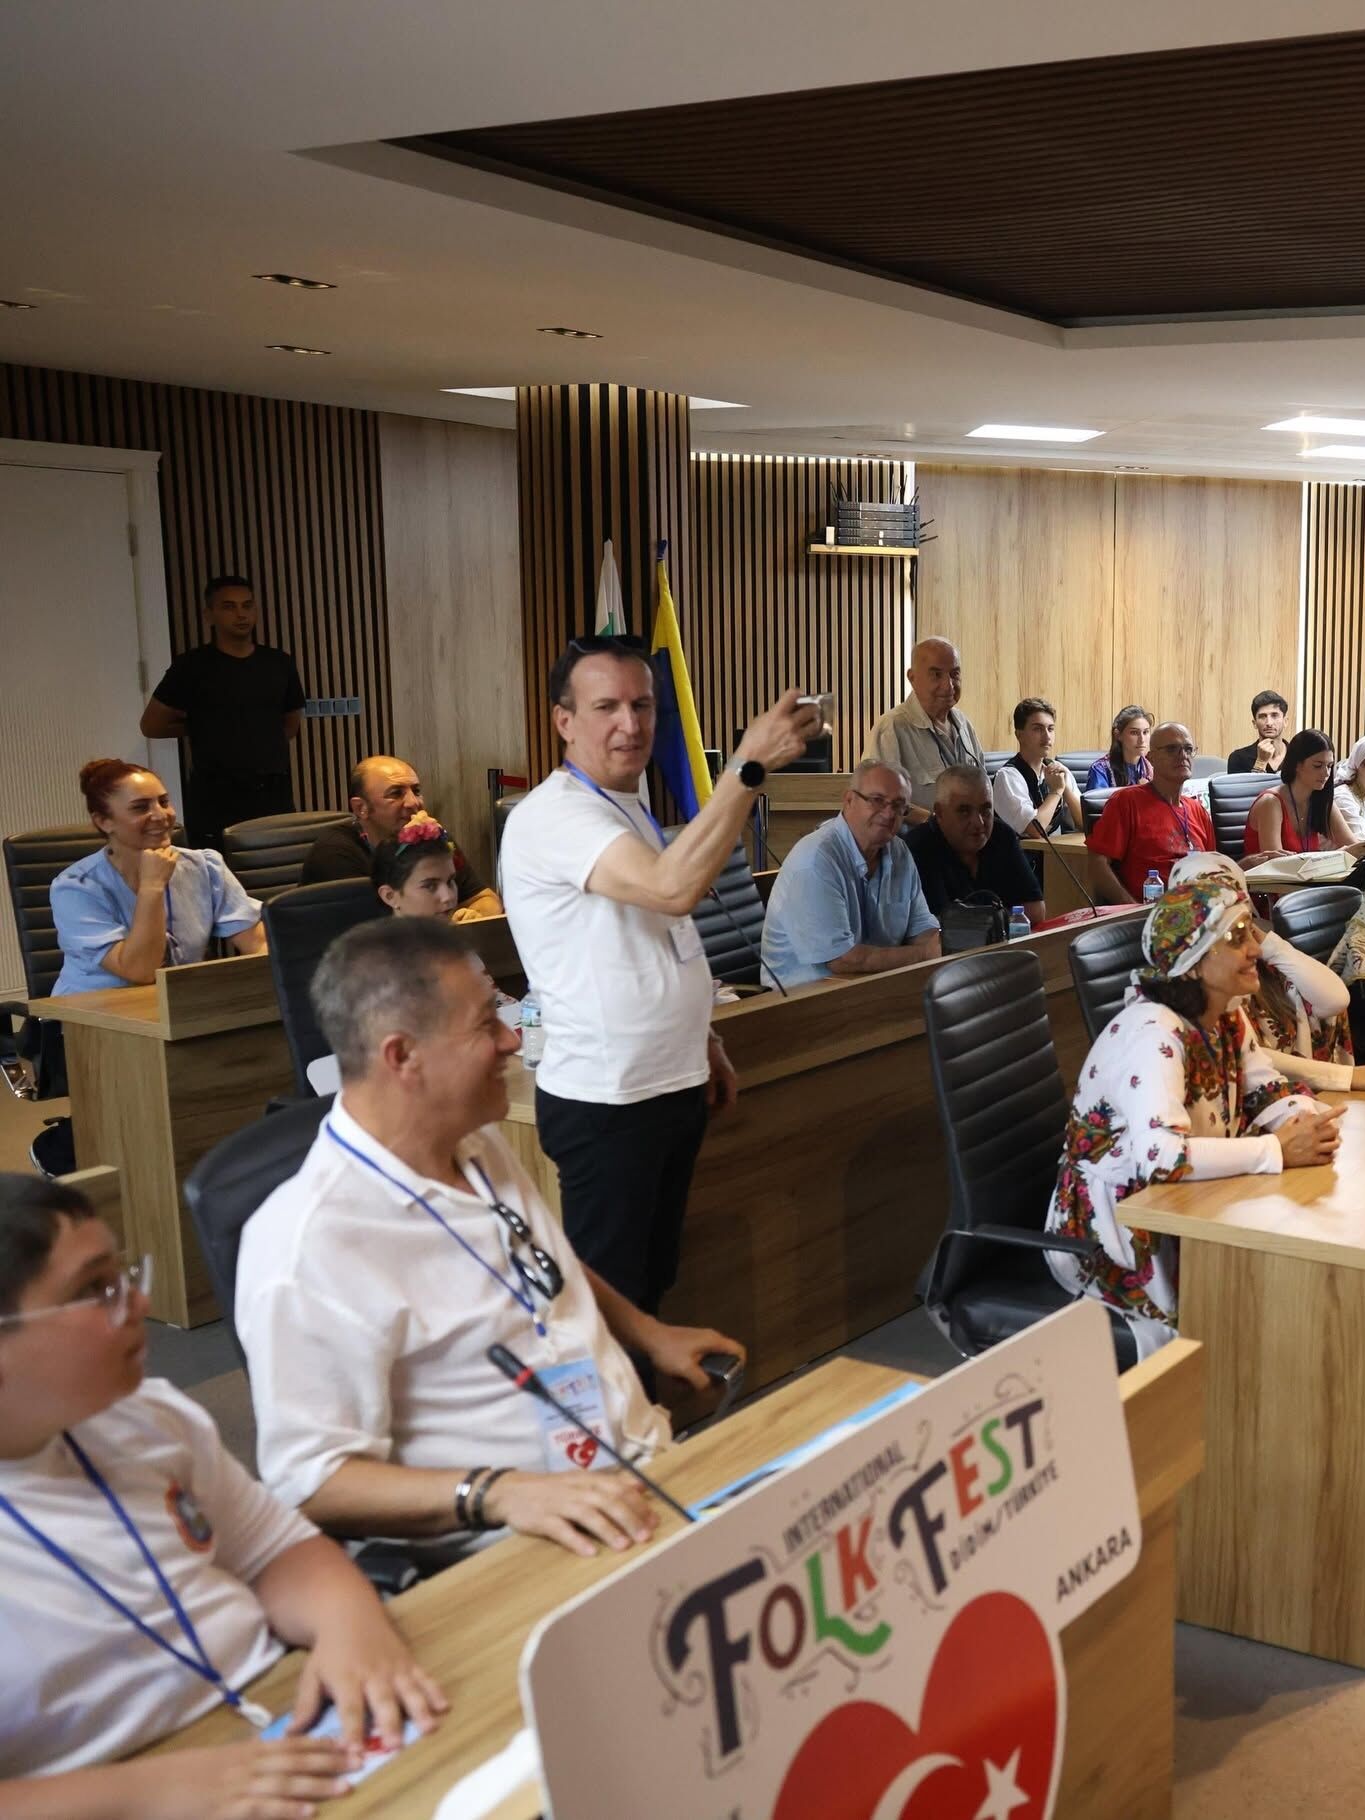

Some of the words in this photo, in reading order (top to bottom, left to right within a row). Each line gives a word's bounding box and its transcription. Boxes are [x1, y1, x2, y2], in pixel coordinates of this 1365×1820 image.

[783, 1440, 905, 1553] INTERNATIONAL
[666, 1515, 892, 1758] FOLK
[888, 1398, 1044, 1595] FEST
[1056, 1526, 1132, 1603] ANKARA
